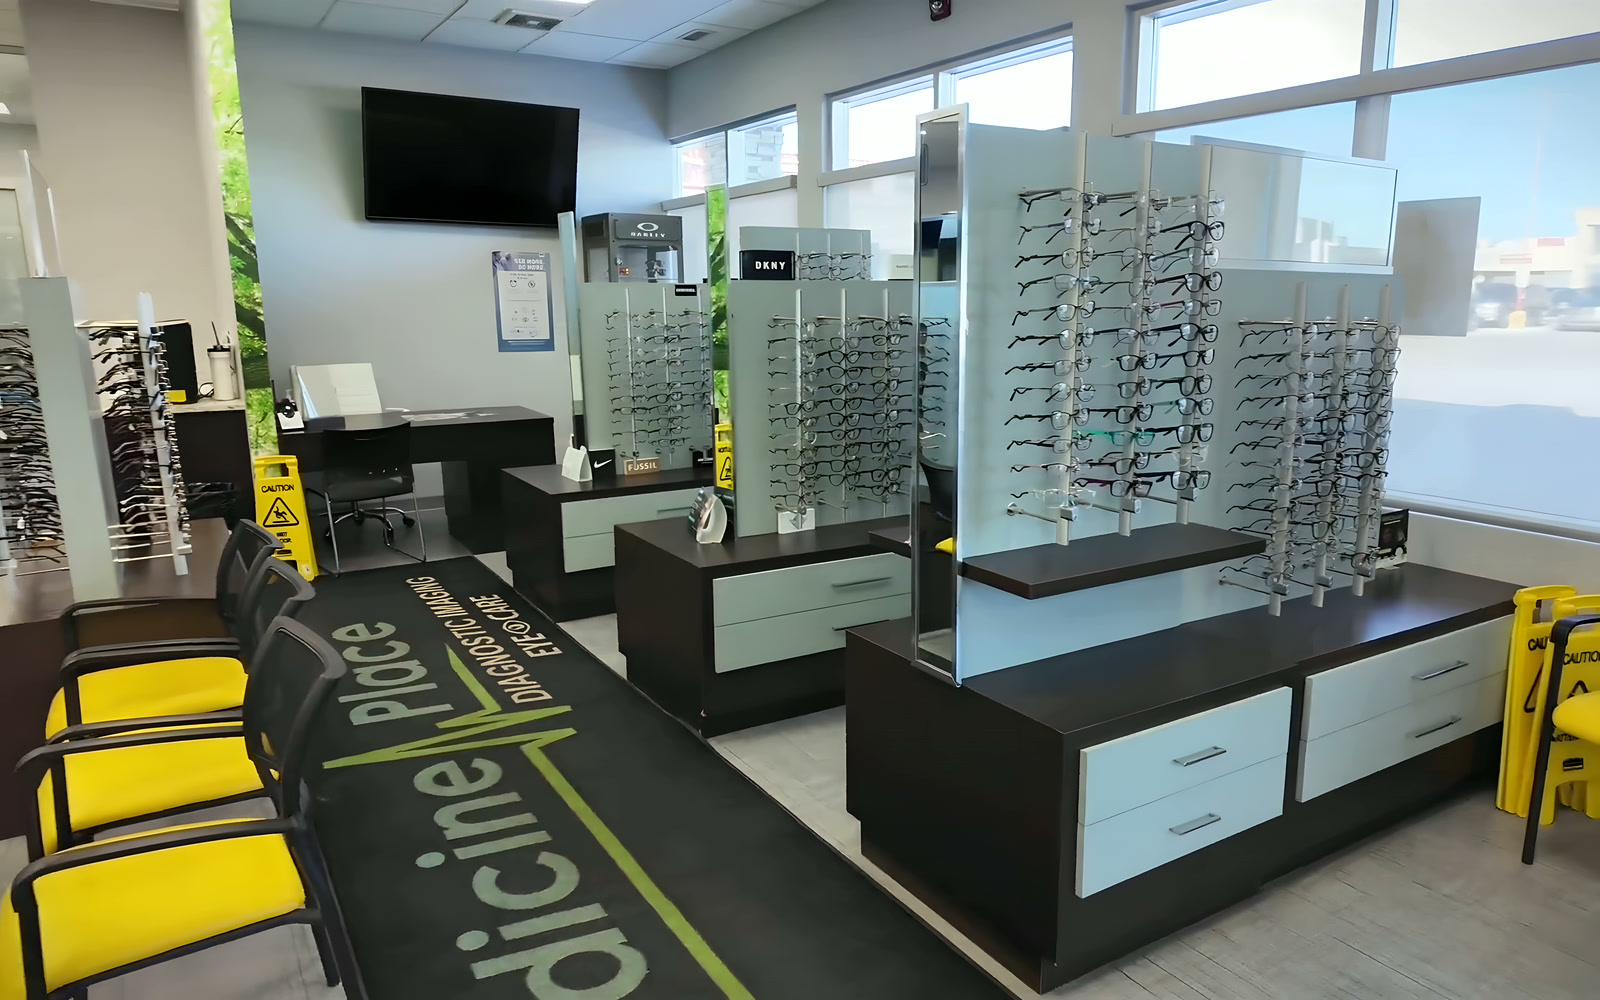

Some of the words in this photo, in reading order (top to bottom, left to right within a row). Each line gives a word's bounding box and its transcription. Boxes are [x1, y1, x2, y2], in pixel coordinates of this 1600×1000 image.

[755, 261, 786, 270] DKNY
[261, 484, 294, 493] CAUTION
[405, 576, 469, 618] IMAGING
[469, 594, 520, 621] CARE
[510, 632, 563, 658] EYE
[1563, 650, 1600, 665] CAUTIO
[331, 621, 455, 726] Place
[444, 618, 553, 704] DIAGNOSTIC
